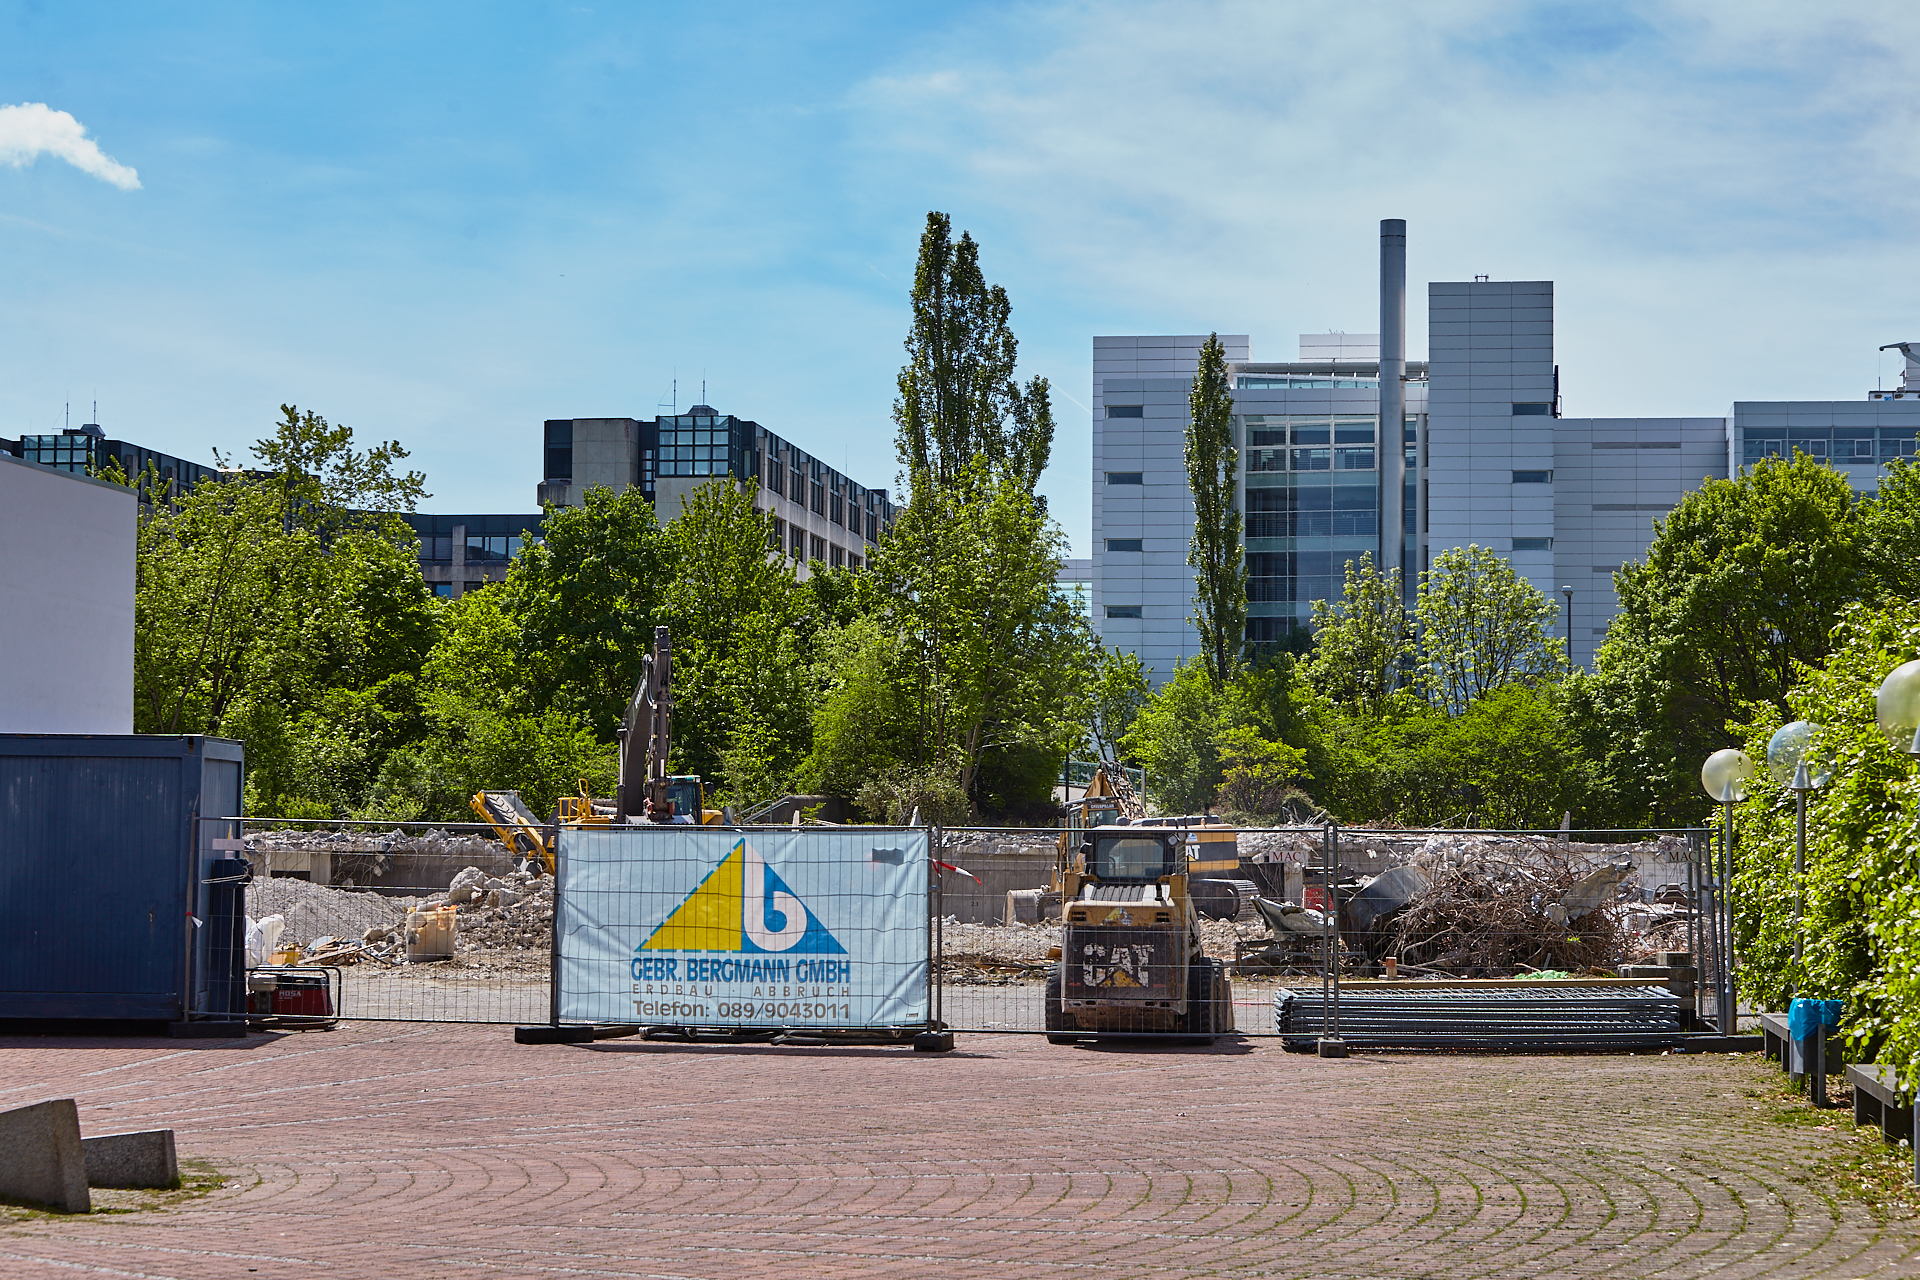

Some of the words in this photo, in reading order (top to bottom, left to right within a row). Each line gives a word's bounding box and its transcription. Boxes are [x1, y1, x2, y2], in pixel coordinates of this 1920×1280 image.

[1272, 851, 1301, 862] MAC
[1669, 851, 1697, 861] MAC
[631, 957, 682, 982] GEBR.
[687, 957, 790, 983] BERGMANN
[796, 958, 850, 984] GMBH
[632, 983, 713, 996] ERDBAU
[753, 985, 850, 997] ABBRUCH
[632, 1000, 710, 1018] Telefon:
[718, 1002, 850, 1019] 089/9043011
